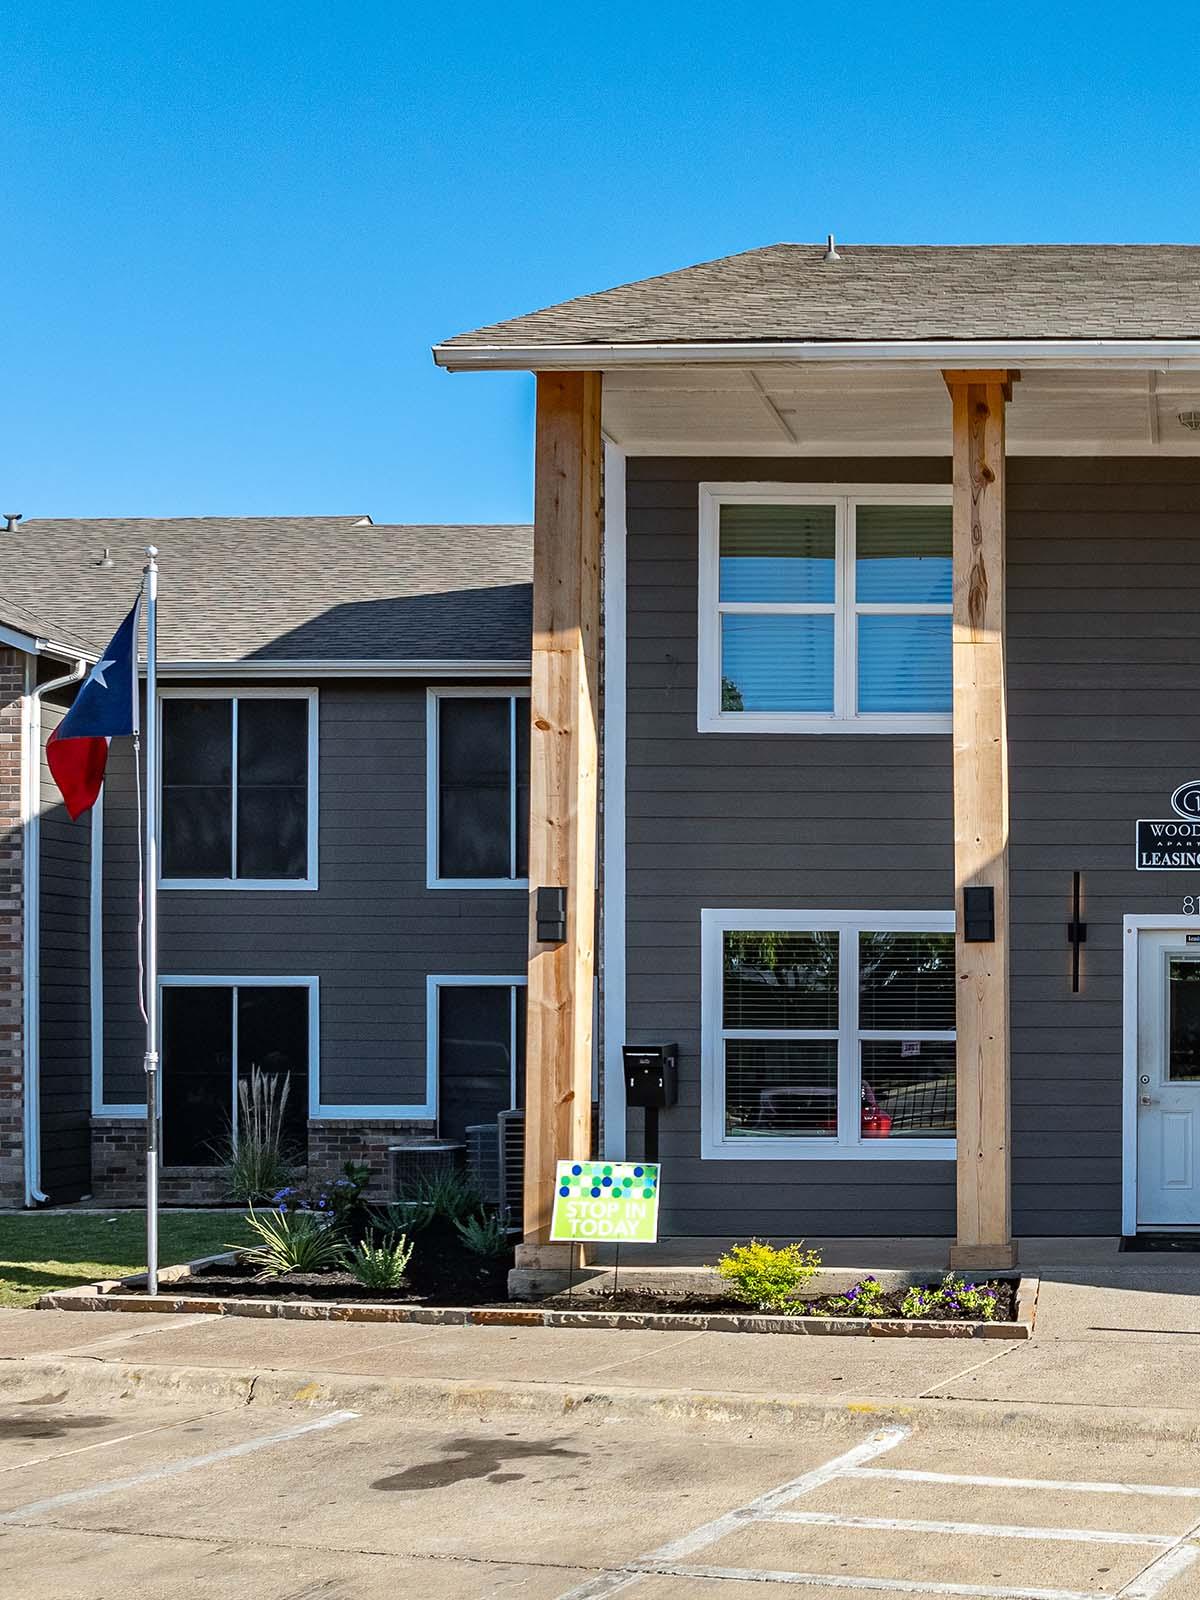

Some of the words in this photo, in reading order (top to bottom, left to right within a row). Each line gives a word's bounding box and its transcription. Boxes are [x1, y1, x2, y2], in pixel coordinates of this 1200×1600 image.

[565, 1201, 620, 1218] STOP
[626, 1201, 646, 1219] IN
[568, 1218, 640, 1236] TODAY
